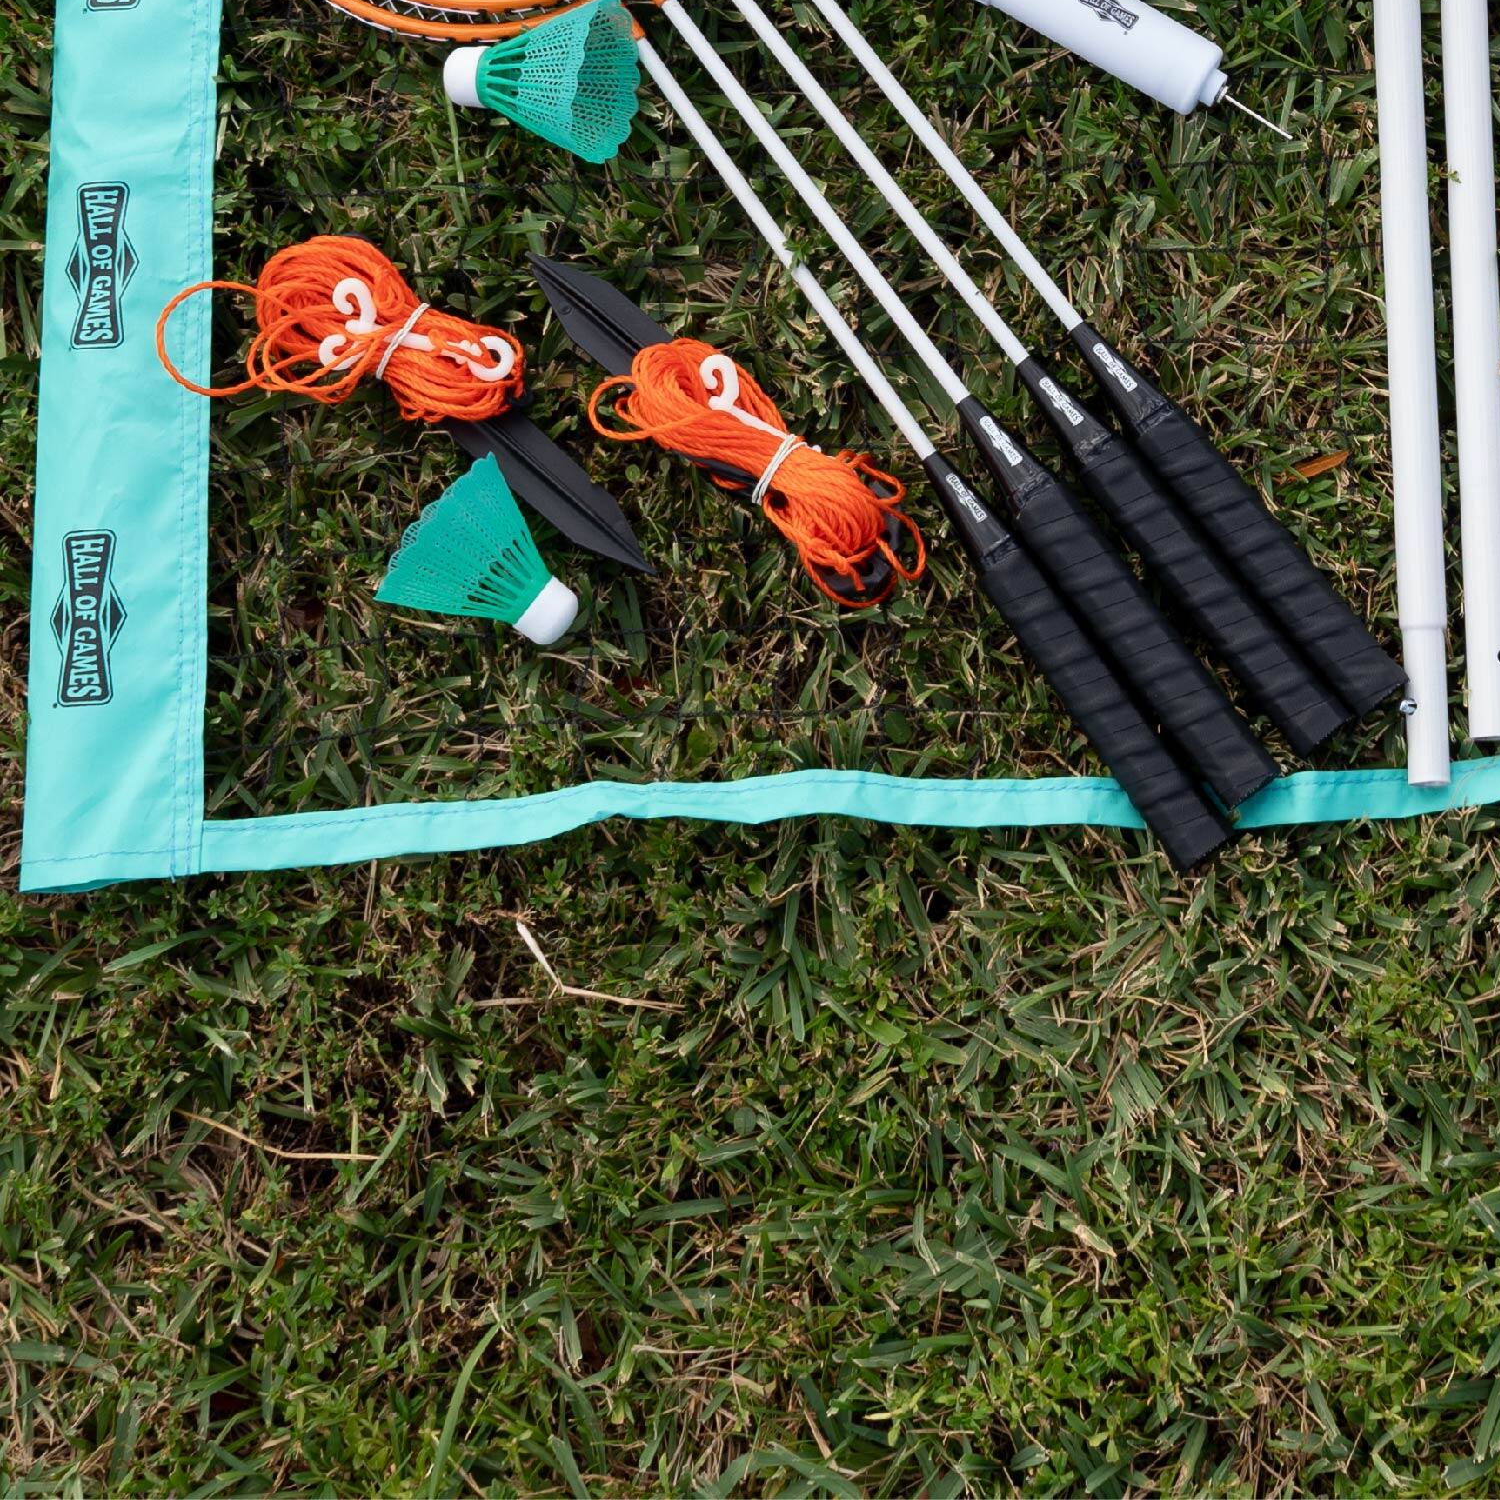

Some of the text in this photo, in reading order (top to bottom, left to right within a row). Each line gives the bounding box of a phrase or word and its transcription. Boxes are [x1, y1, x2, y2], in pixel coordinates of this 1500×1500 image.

[79, 190, 118, 341] HALL OF GAMES
[66, 537, 105, 698] HALL OF GAMES
